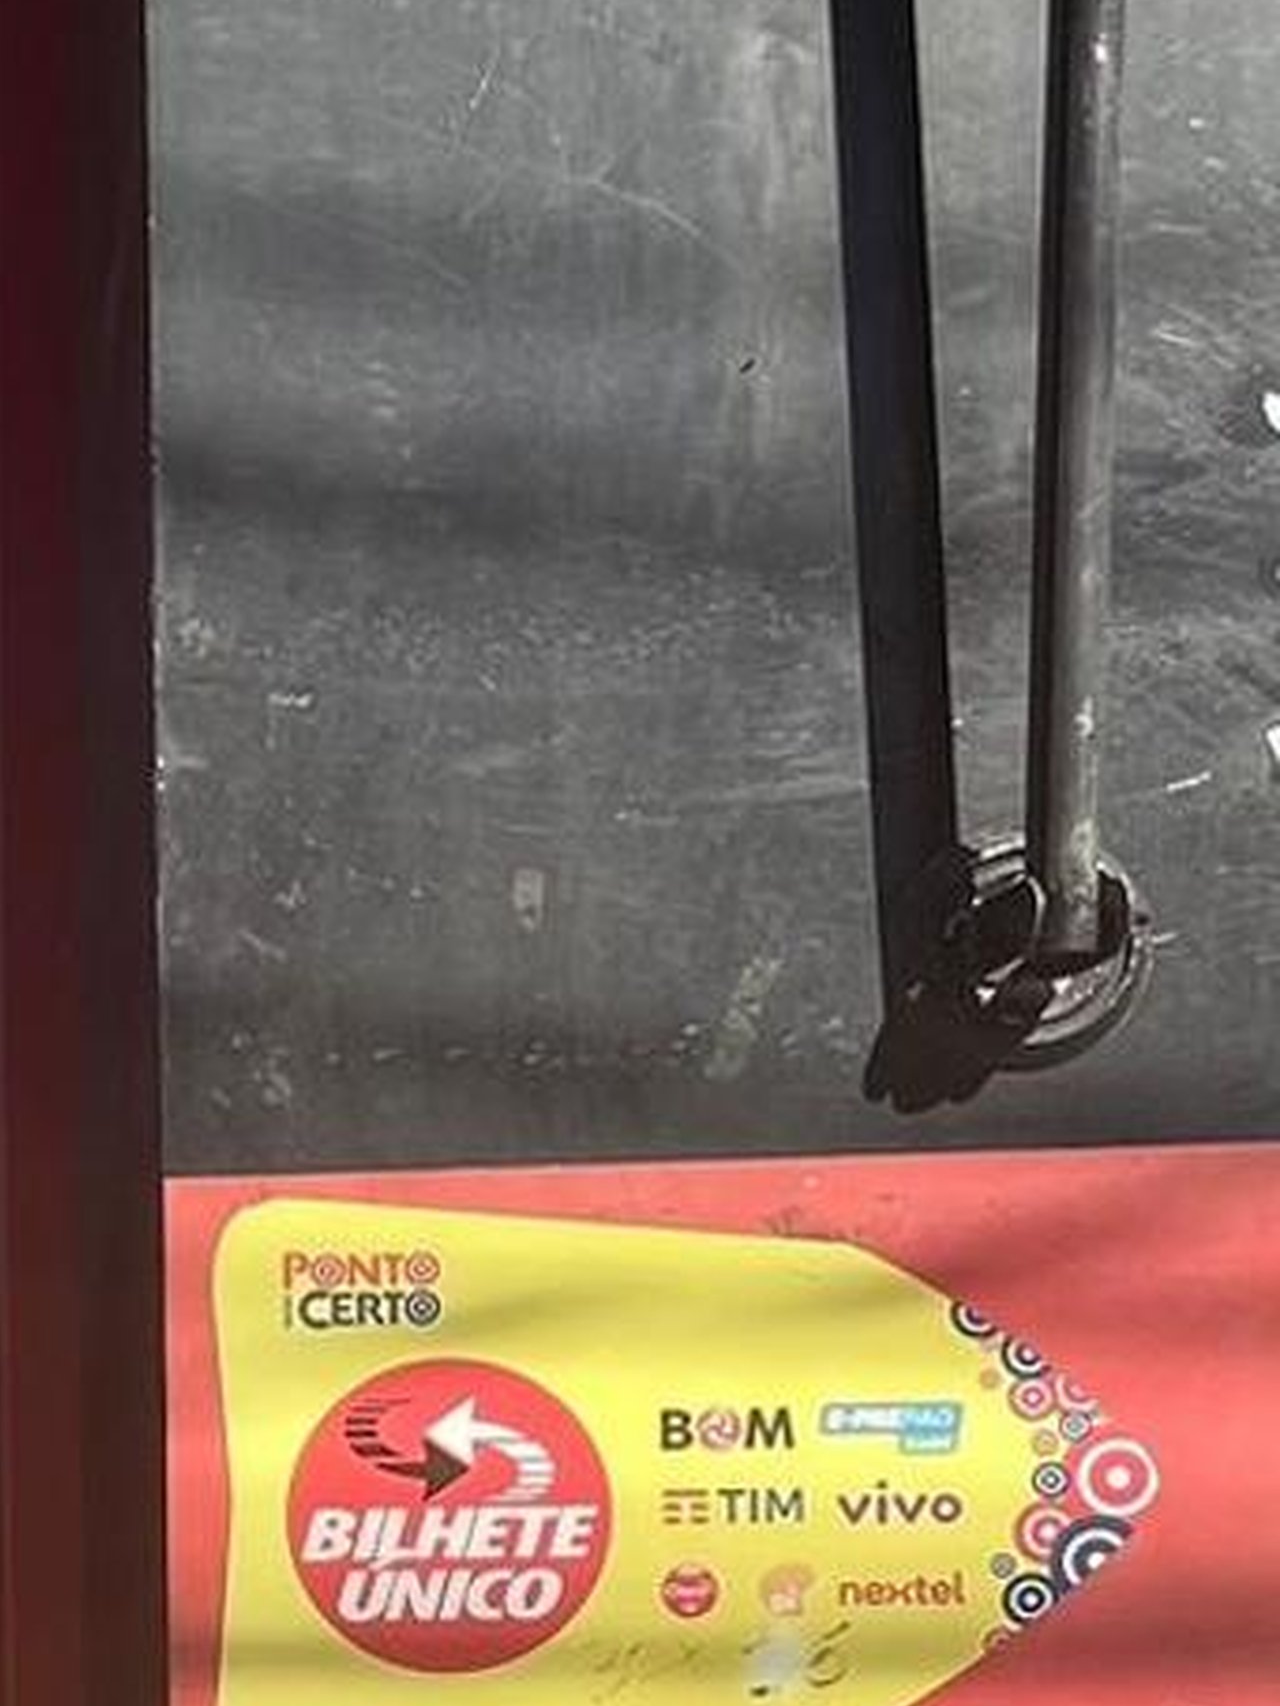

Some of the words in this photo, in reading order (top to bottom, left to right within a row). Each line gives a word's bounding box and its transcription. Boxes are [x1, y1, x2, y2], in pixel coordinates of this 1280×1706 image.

[283, 1250, 440, 1290] PONTO
[298, 1289, 441, 1329] CERTO
[660, 1406, 795, 1451] BOM
[717, 1488, 804, 1524] TIM
[838, 1480, 963, 1524] vivo
[300, 1503, 600, 1564] BILHETE
[336, 1551, 564, 1623] ÚNICO
[838, 1570, 966, 1608] nextel
